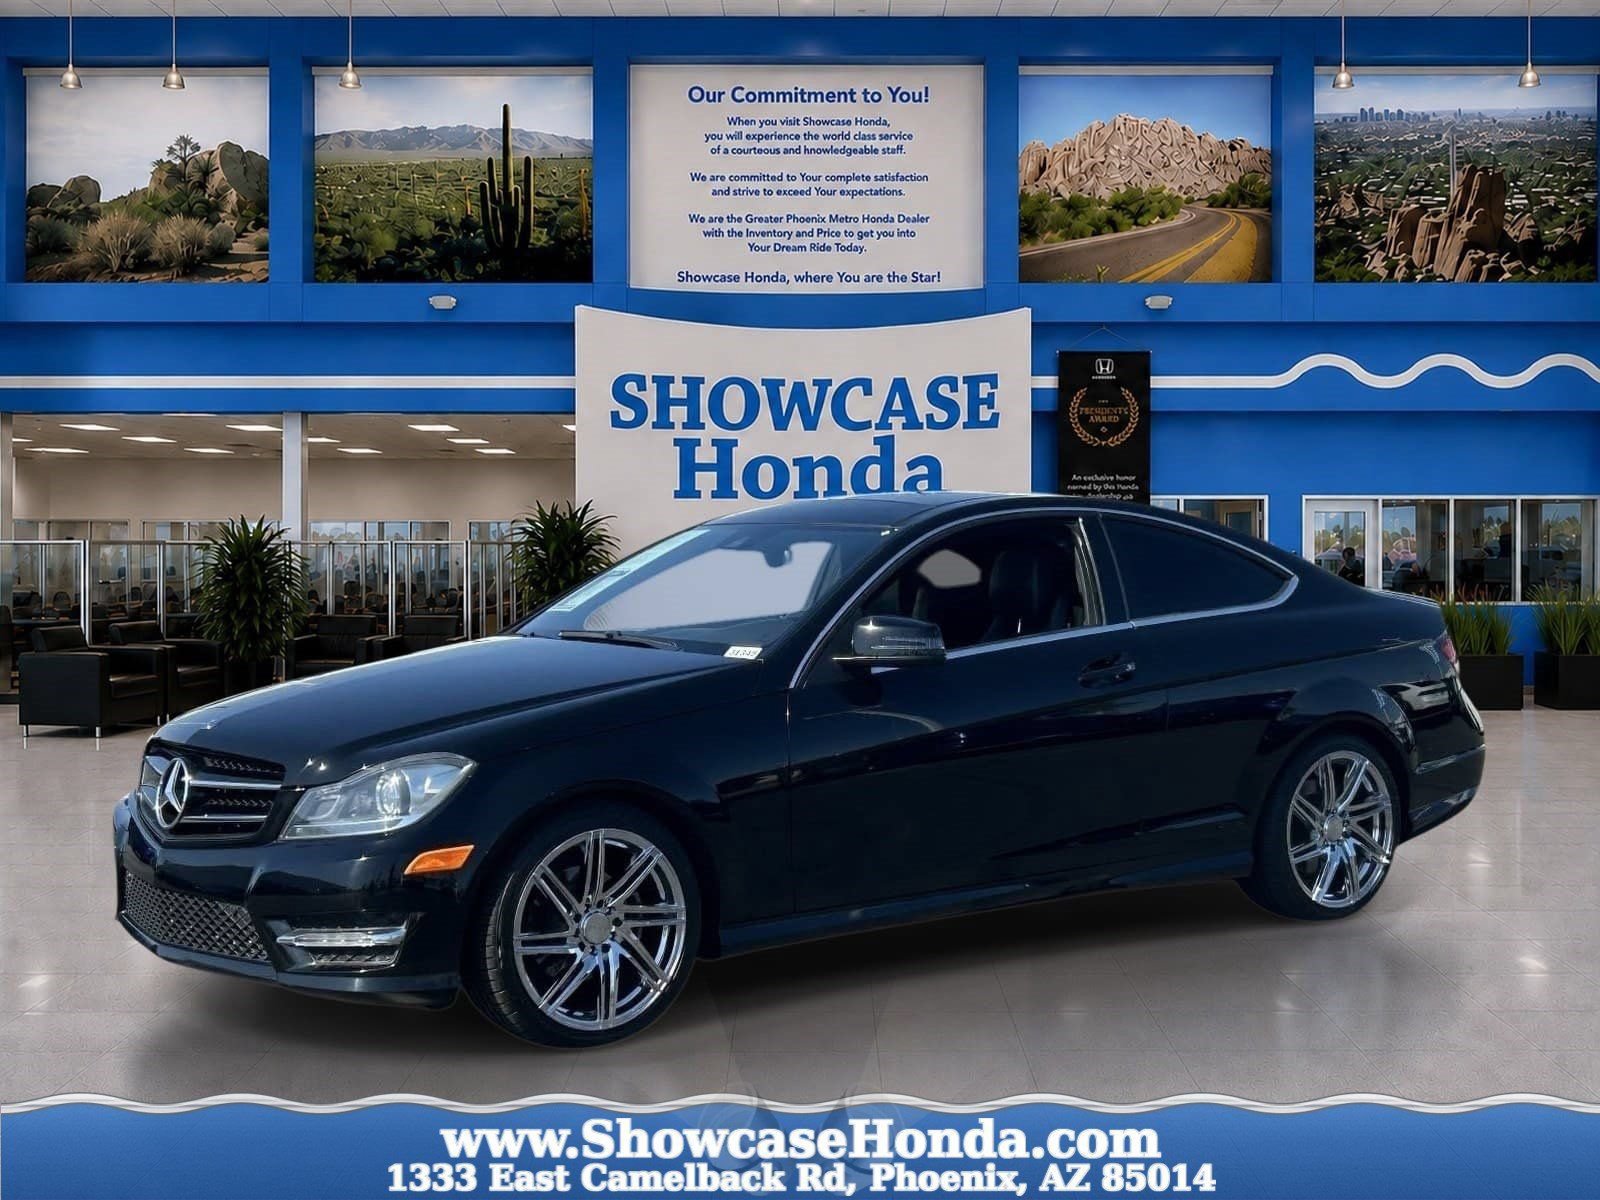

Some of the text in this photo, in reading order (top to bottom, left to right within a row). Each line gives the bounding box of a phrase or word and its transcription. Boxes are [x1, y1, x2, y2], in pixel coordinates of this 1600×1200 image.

[687, 85, 930, 104] Our Commitment to You!
[726, 115, 891, 129] When you visit Showcase Honda,
[704, 130, 914, 144] you will experience the world class service
[709, 144, 722, 155] of
[722, 147, 730, 155] a
[730, 146, 782, 156] courteous
[782, 144, 802, 155] and
[881, 144, 907, 155] staff.
[689, 171, 929, 185] We are committed to Your complete satisfaction
[711, 185, 906, 200] and strive to exceed Your expectations.
[688, 213, 931, 224] We are the Greater Phoenix Metro Honda Dealer
[702, 227, 917, 241] with the Inventory and Price to get you into
[747, 242, 868, 255] Your Dream Ride Today.
[676, 270, 941, 286] Showcase Honda, where You are the Star!
[610, 373, 1000, 431] SHOWCASE
[673, 434, 943, 499] Honda
